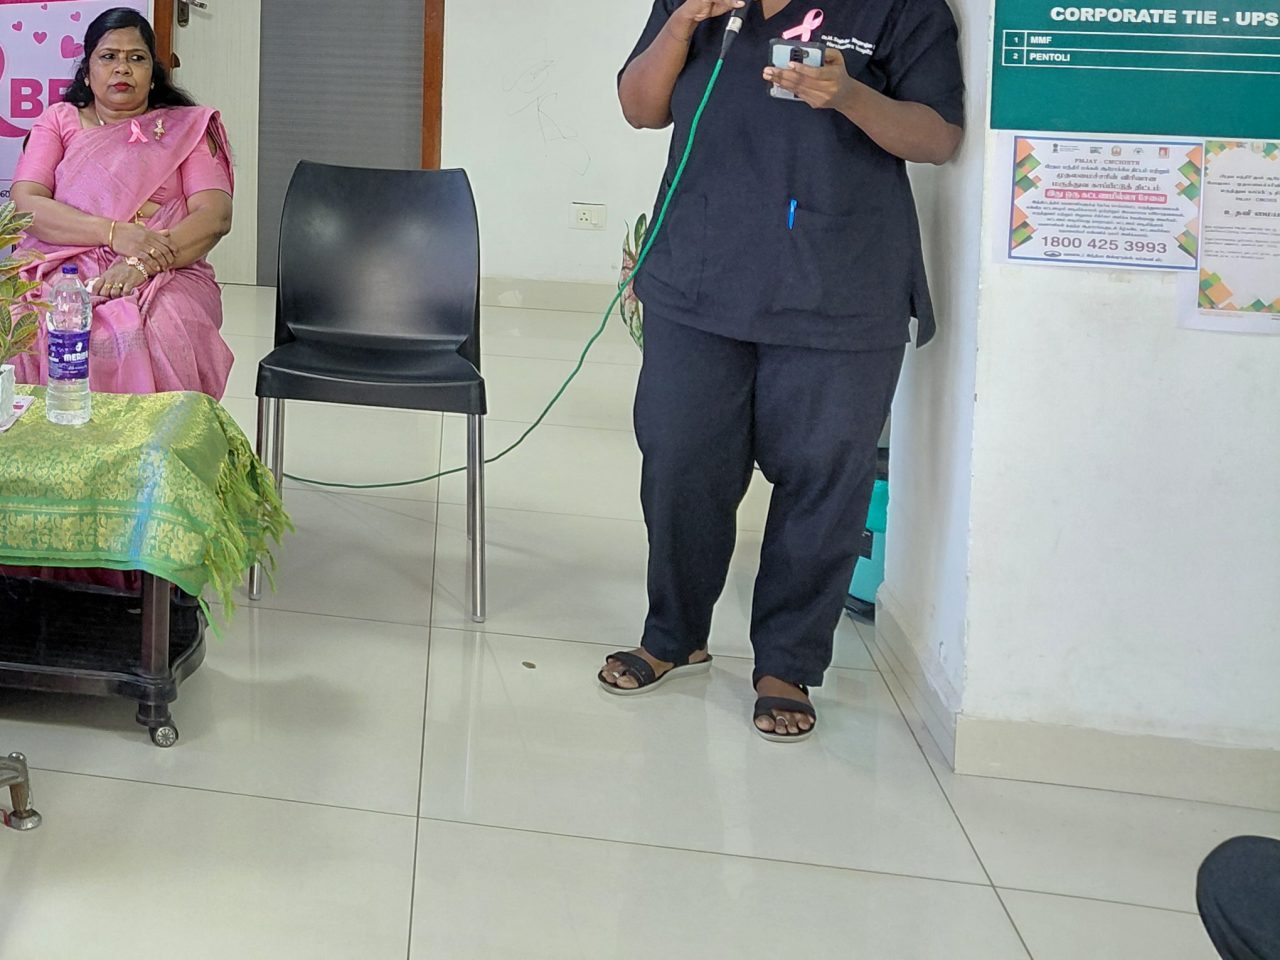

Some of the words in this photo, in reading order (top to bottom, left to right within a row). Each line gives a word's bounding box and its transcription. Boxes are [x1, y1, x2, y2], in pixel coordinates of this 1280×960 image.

[1050, 7, 1177, 24] CORPORATE
[1182, 10, 1217, 25] TIE
[1236, 12, 1278, 27] UPS
[1031, 36, 1052, 44] MMF
[1030, 53, 1070, 62] PENTOLI
[1042, 236, 1082, 248] 1800
[1088, 238, 1119, 251] 425
[1124, 240, 1167, 254] 3993
